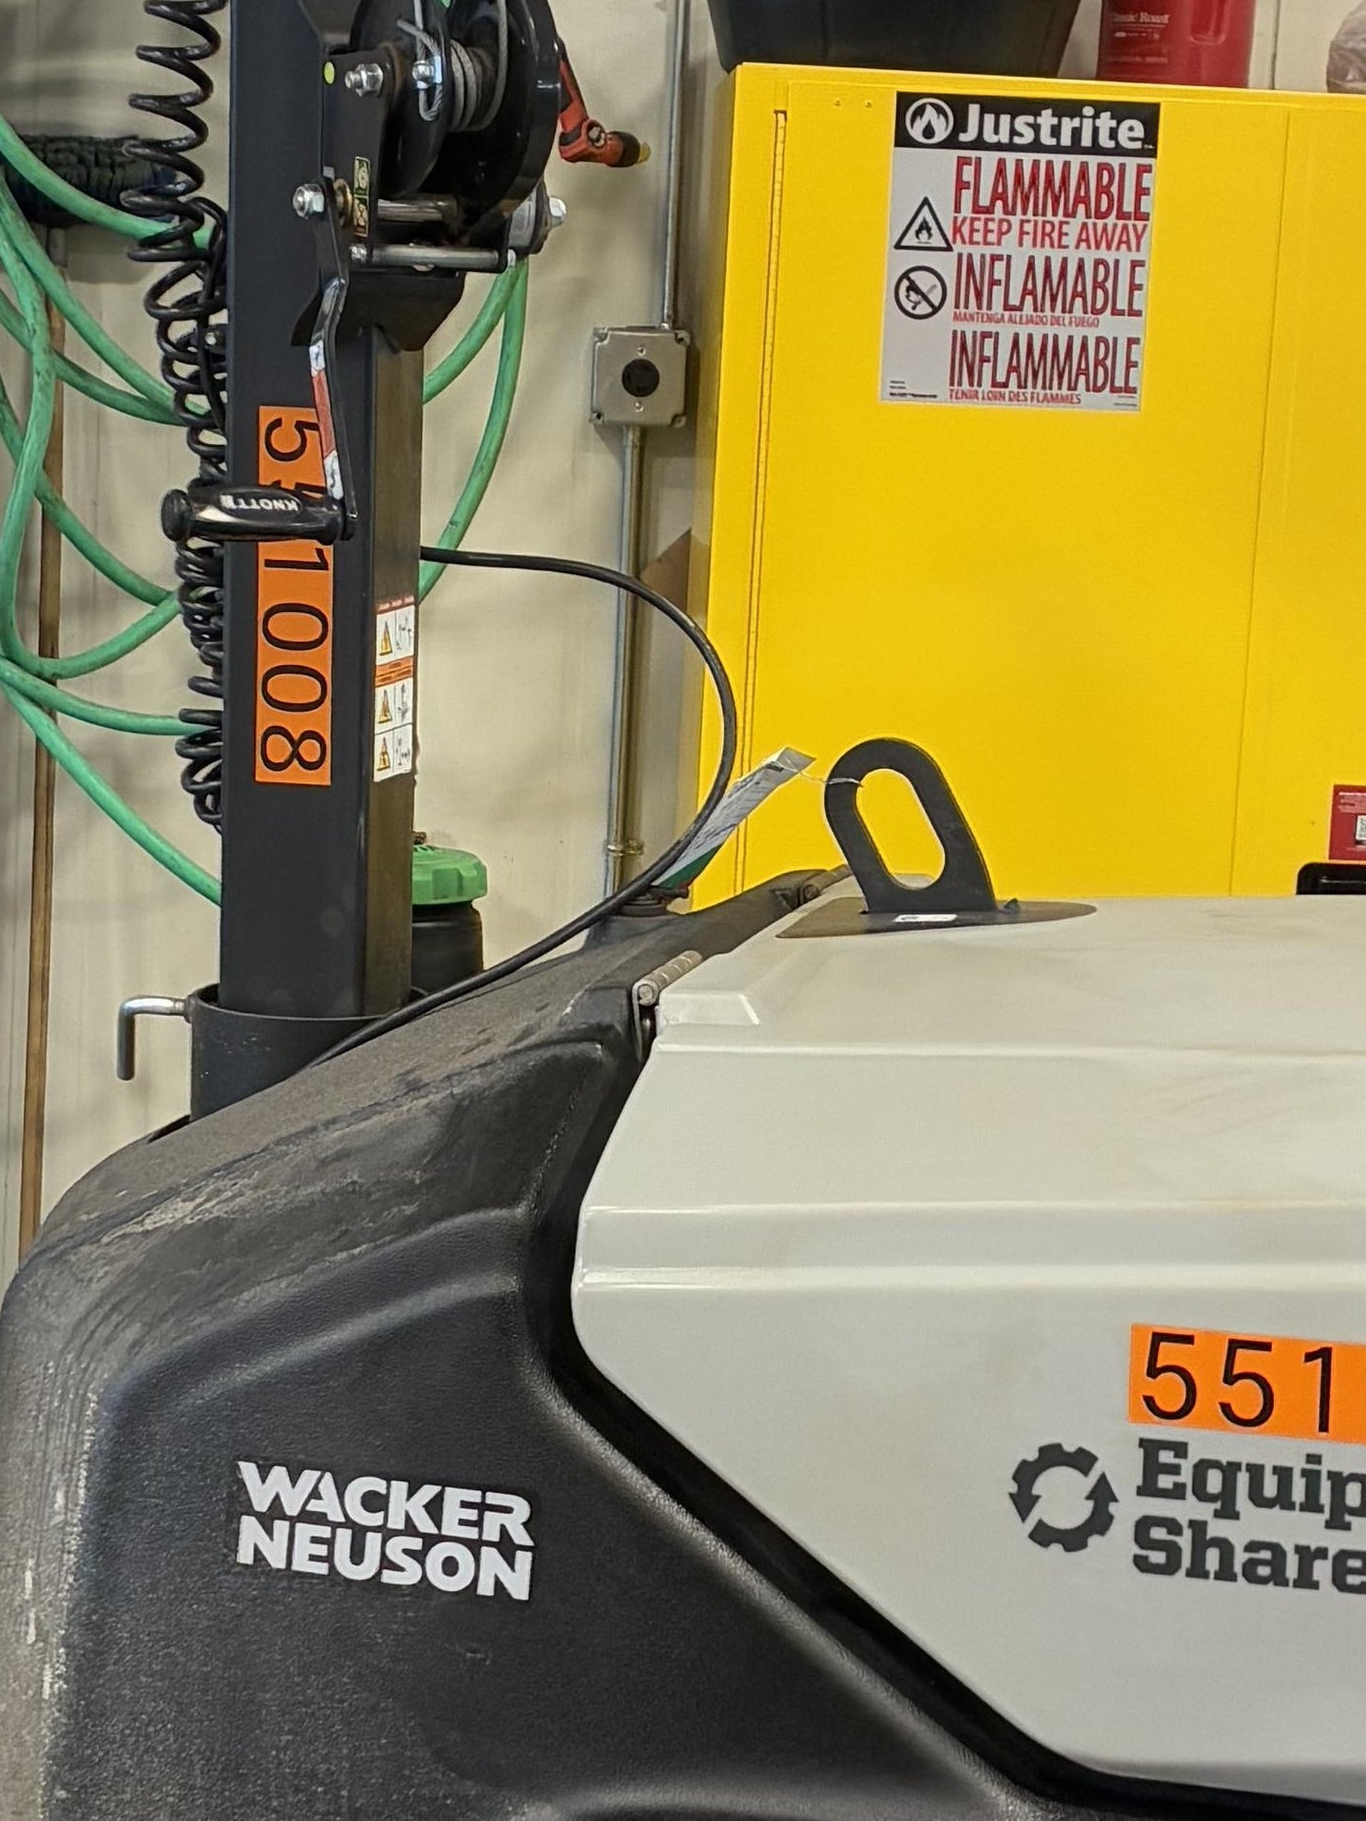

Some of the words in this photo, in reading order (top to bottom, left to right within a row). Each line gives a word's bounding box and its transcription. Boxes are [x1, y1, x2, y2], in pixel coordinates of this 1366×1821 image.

[959, 103, 1145, 150] Justrite
[954, 156, 1153, 221] FLAMMABLE
[951, 216, 1012, 247] KEEP
[1018, 219, 1071, 250] FIRE
[1075, 222, 1149, 253] AWAY
[954, 253, 1146, 316] INFLAMABLE
[953, 312, 1006, 325] MANTENGA
[1050, 314, 1066, 327] DEL
[1068, 316, 1100, 329] FUEGO
[949, 330, 1141, 394] INFLAMMABLE
[1008, 391, 1028, 403] DES
[1030, 392, 1081, 405] FLAMMES
[233, 496, 300, 512] KNOTT
[259, 414, 330, 774] 51008
[236, 1461, 535, 1548] WACKER
[236, 1515, 533, 1601] NEUSON
